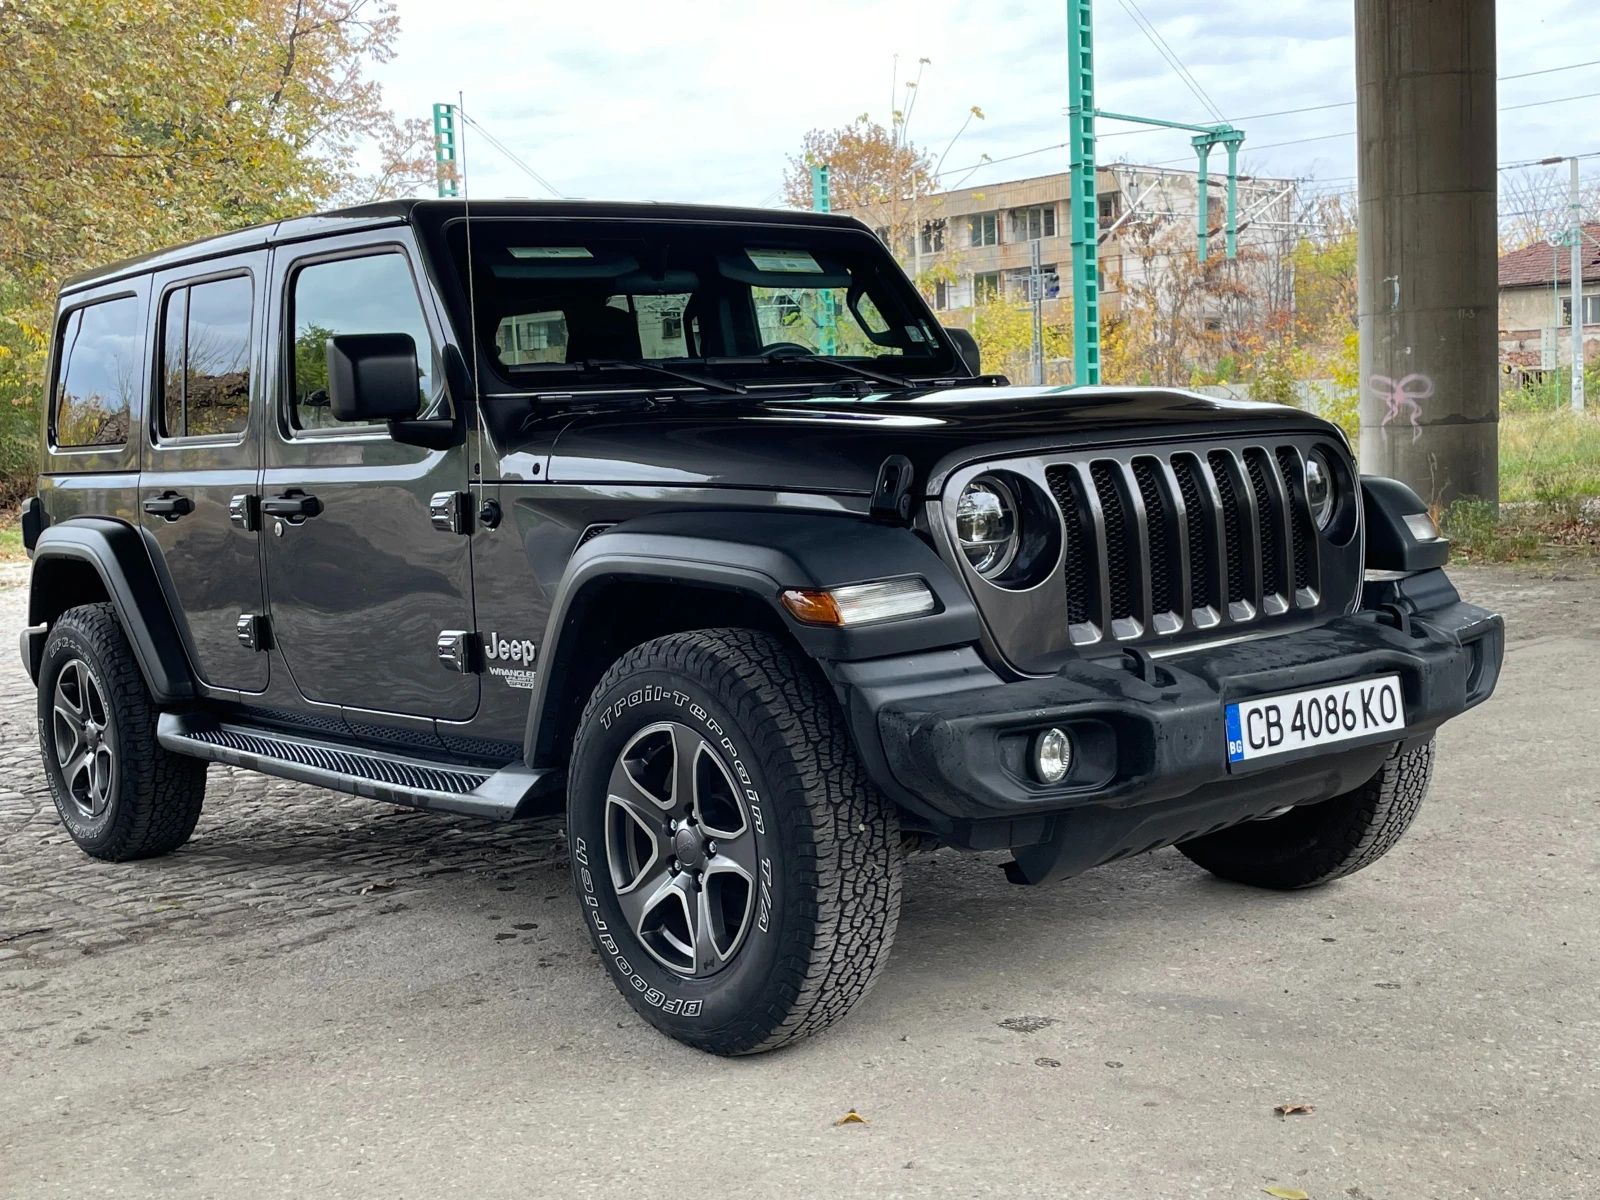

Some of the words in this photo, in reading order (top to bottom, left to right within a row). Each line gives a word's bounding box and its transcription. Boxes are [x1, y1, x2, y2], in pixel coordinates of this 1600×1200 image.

[485, 632, 535, 667] Jeep
[1229, 740, 1242, 755] BG
[1247, 704, 1284, 750] CB
[1291, 691, 1356, 741] 4086
[1360, 684, 1397, 729] KO
[600, 684, 765, 836] Trail-Terrain
[757, 857, 773, 933] T/A
[576, 837, 703, 1017] BFGoodrich
